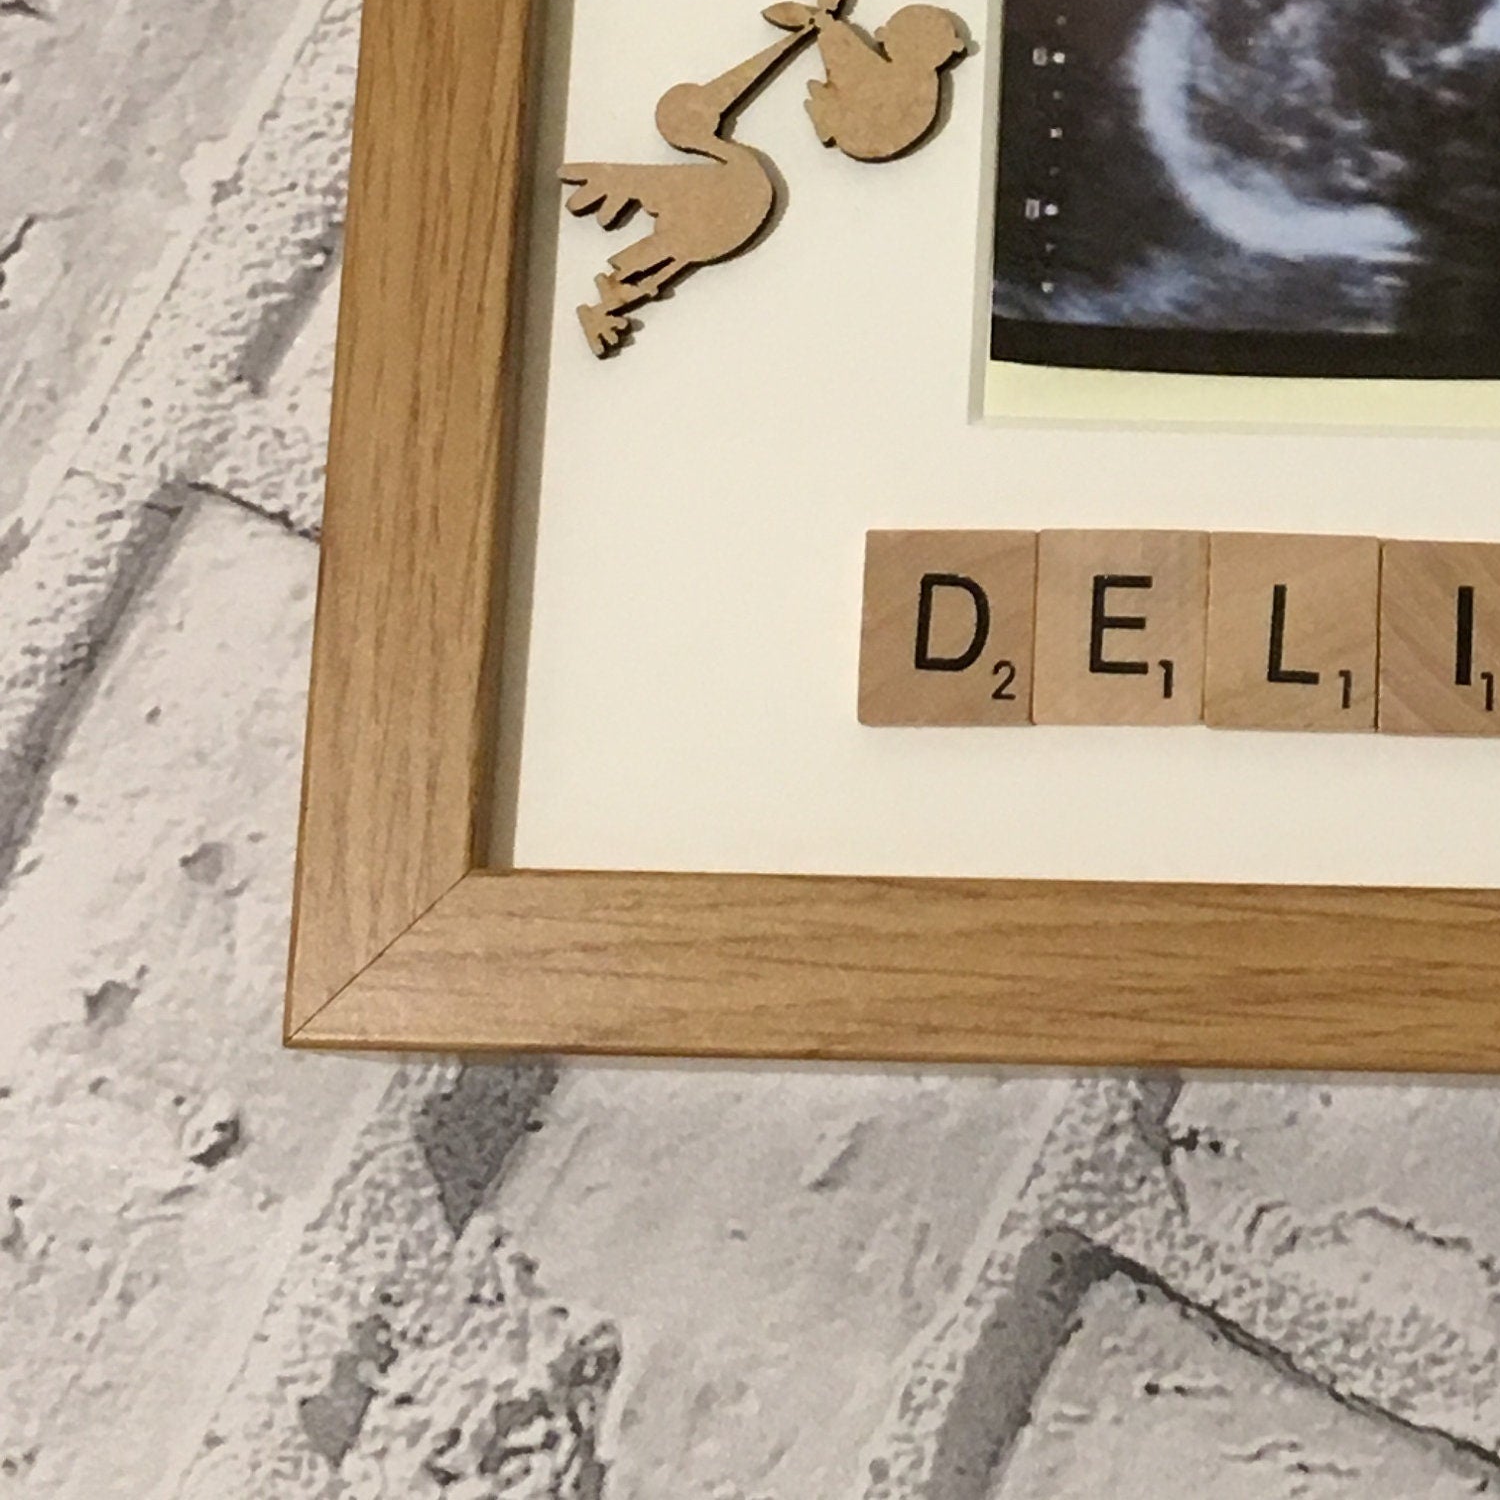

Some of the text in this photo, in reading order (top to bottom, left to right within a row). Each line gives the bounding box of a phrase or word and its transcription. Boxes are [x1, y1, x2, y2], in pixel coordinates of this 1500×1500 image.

[990, 659, 1017, 702] 2
[1157, 658, 1175, 700] 1
[1337, 669, 1353, 710] 1
[1479, 670, 1495, 713] 1
